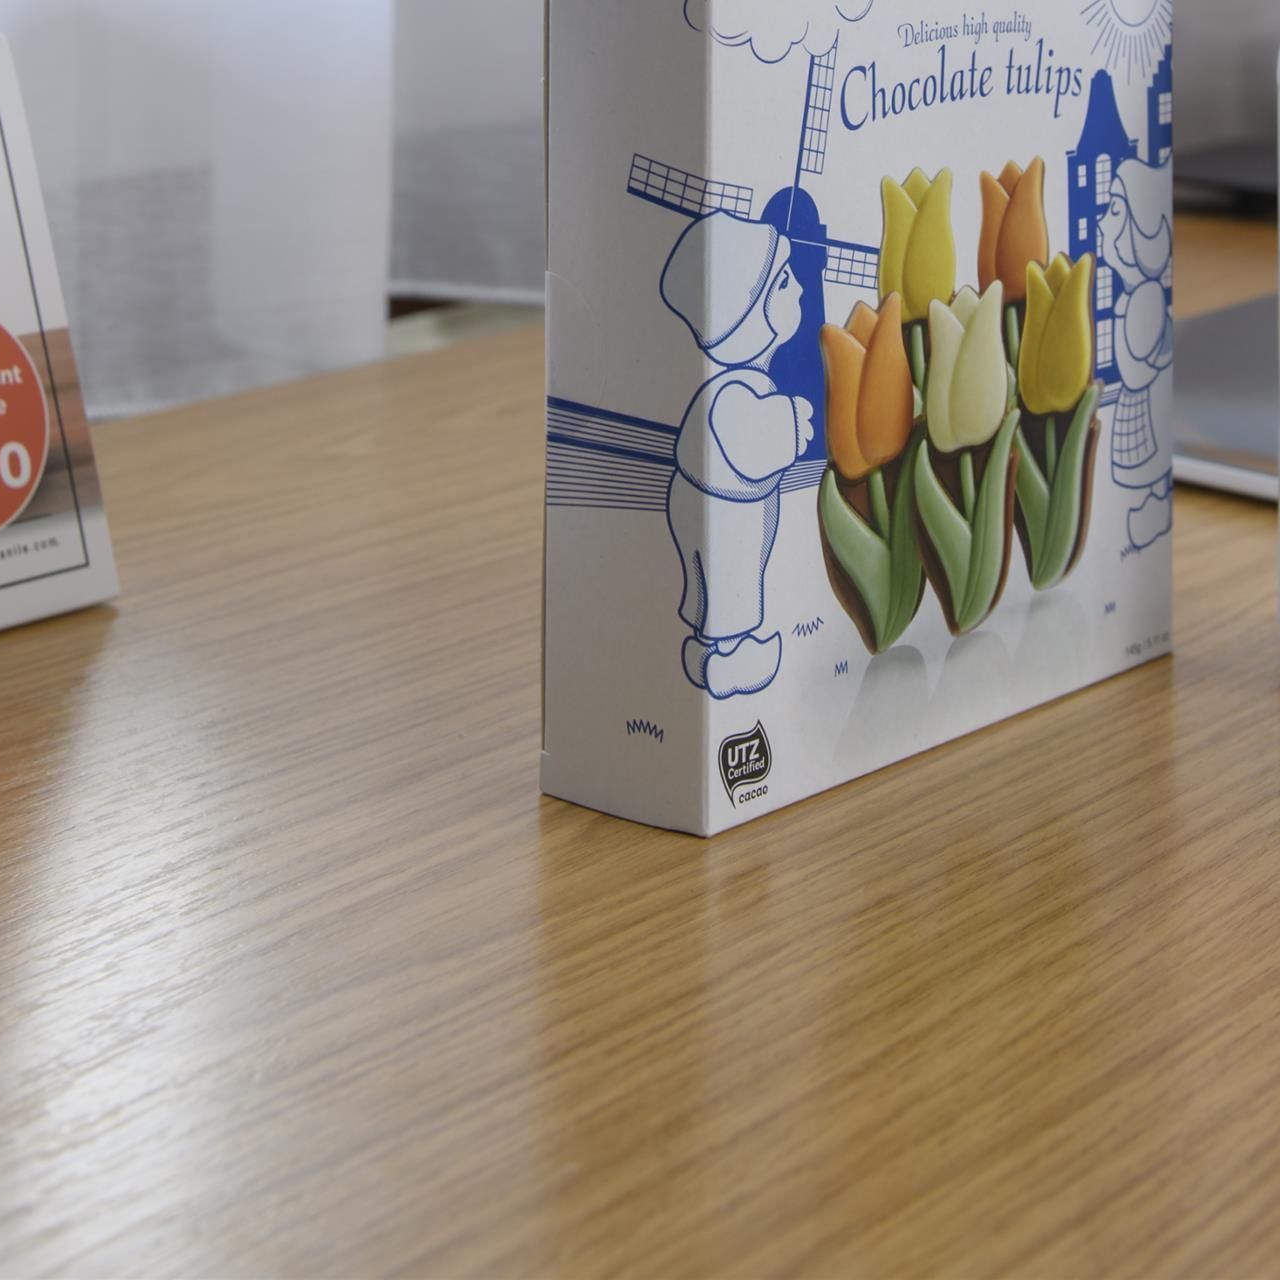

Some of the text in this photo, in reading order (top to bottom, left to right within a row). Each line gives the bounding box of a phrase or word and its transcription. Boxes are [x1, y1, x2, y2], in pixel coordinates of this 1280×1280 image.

[897, 11, 1032, 48] Delicious high quality
[840, 38, 1083, 131] Chocolate tulips
[728, 739, 760, 767] UTZ
[728, 756, 765, 780] Certified
[738, 785, 768, 804] cacao
